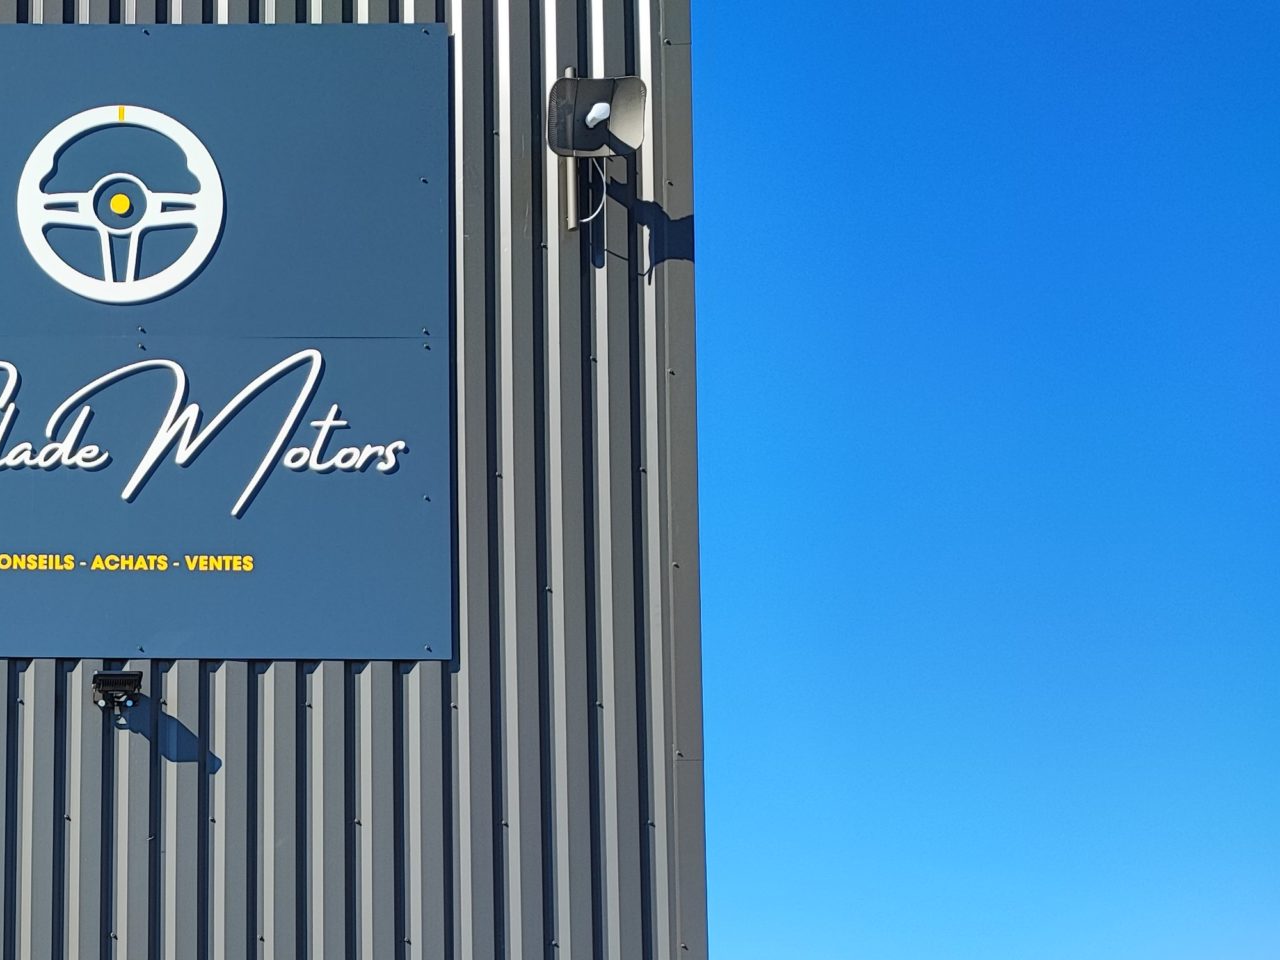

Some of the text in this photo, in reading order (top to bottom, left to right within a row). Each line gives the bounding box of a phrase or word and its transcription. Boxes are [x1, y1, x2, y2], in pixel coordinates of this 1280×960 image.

[46, 348, 408, 516] Motors
[91, 554, 169, 572] ACHATS
[185, 555, 254, 572] VENTES
